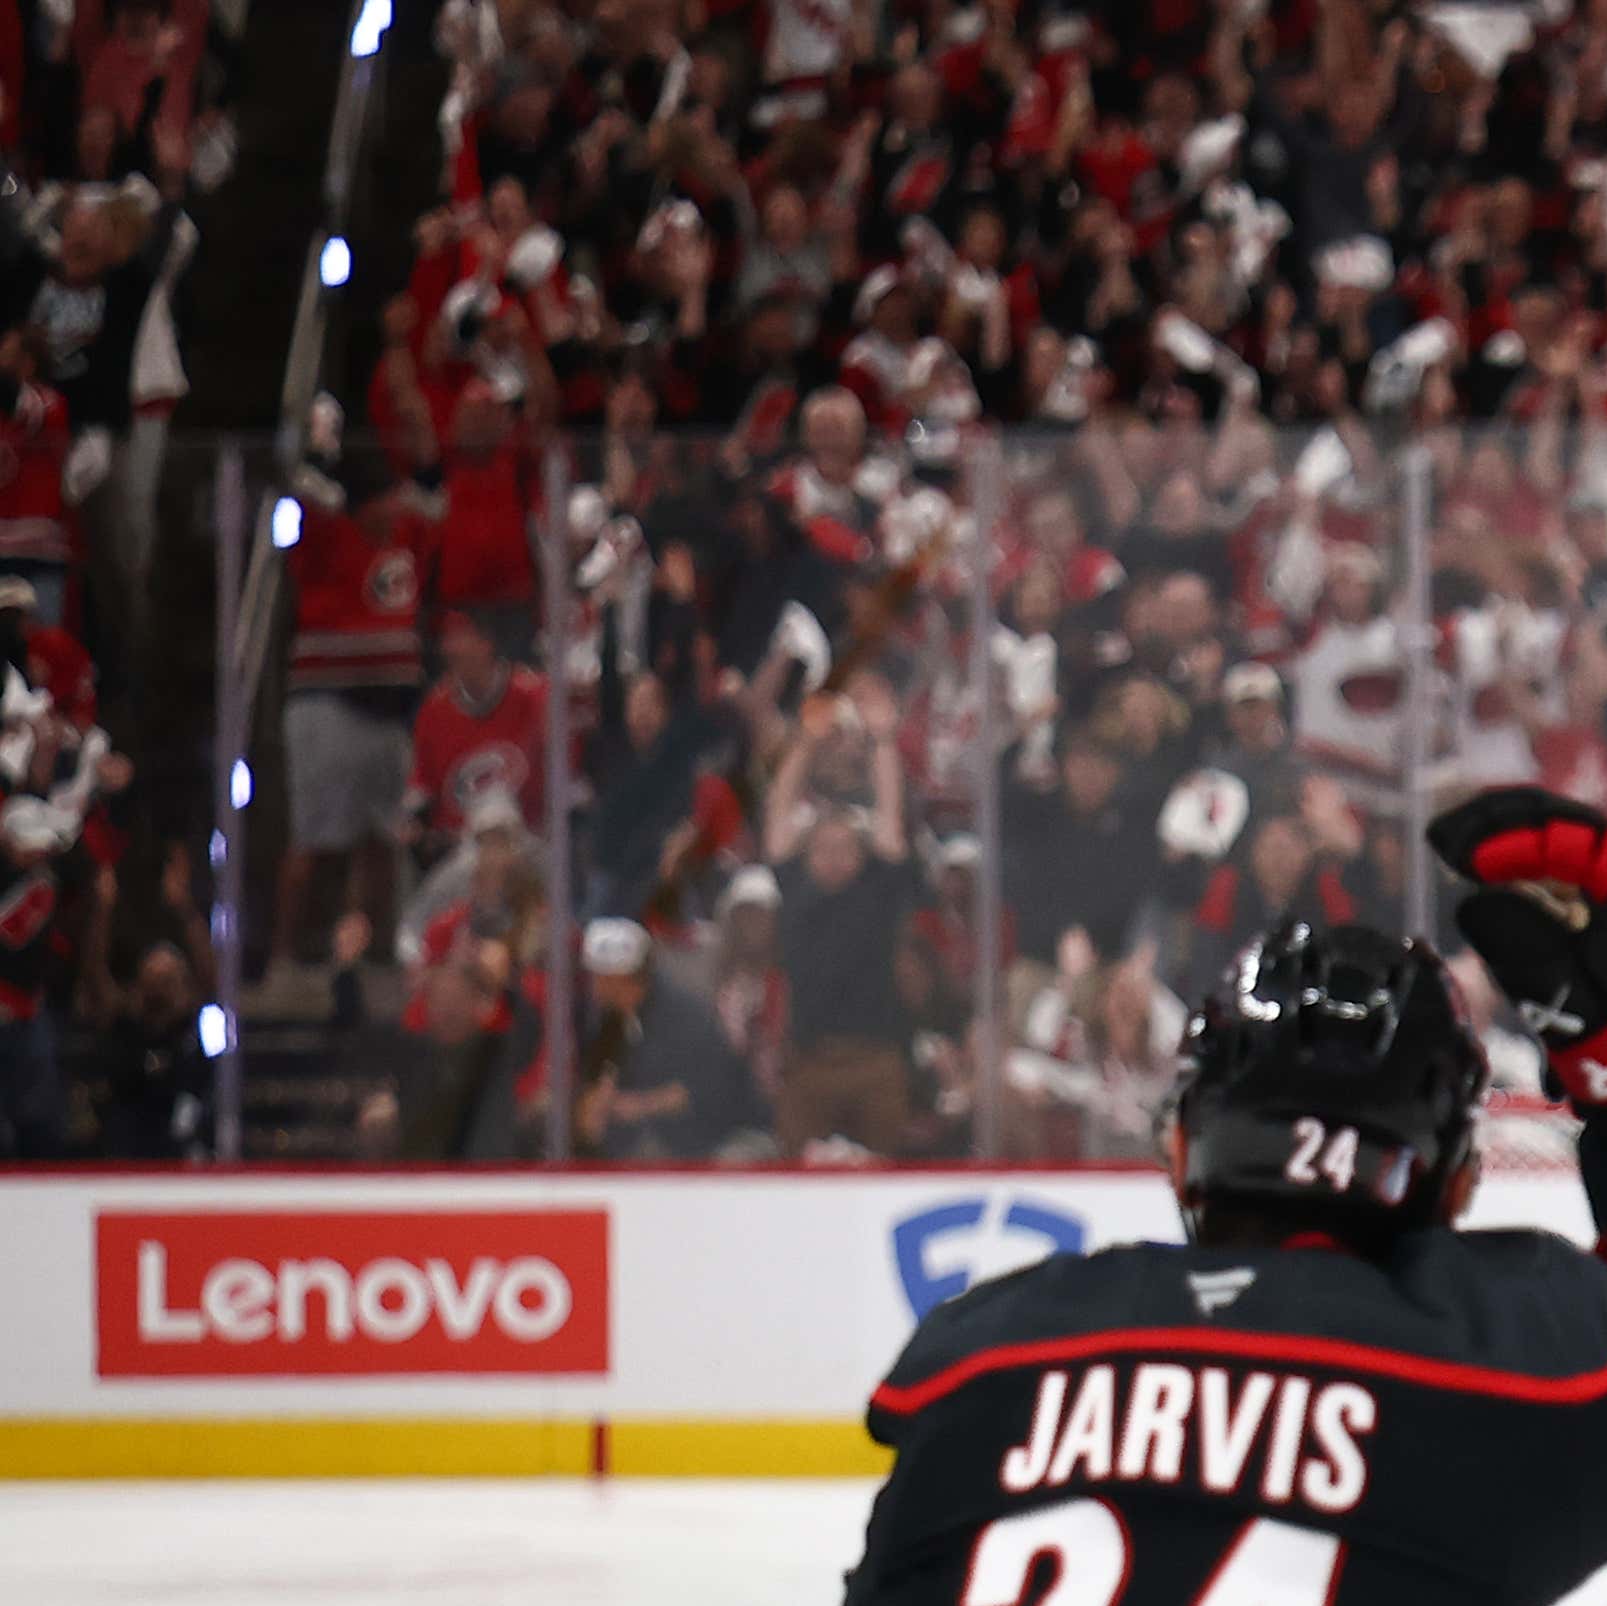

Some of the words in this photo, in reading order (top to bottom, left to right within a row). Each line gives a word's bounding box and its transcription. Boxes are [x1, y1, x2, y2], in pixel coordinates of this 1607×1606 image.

[1285, 1116, 1360, 1192] 24
[137, 1238, 574, 1345] Lenovo
[1000, 1362, 1378, 1513] JARVIS
